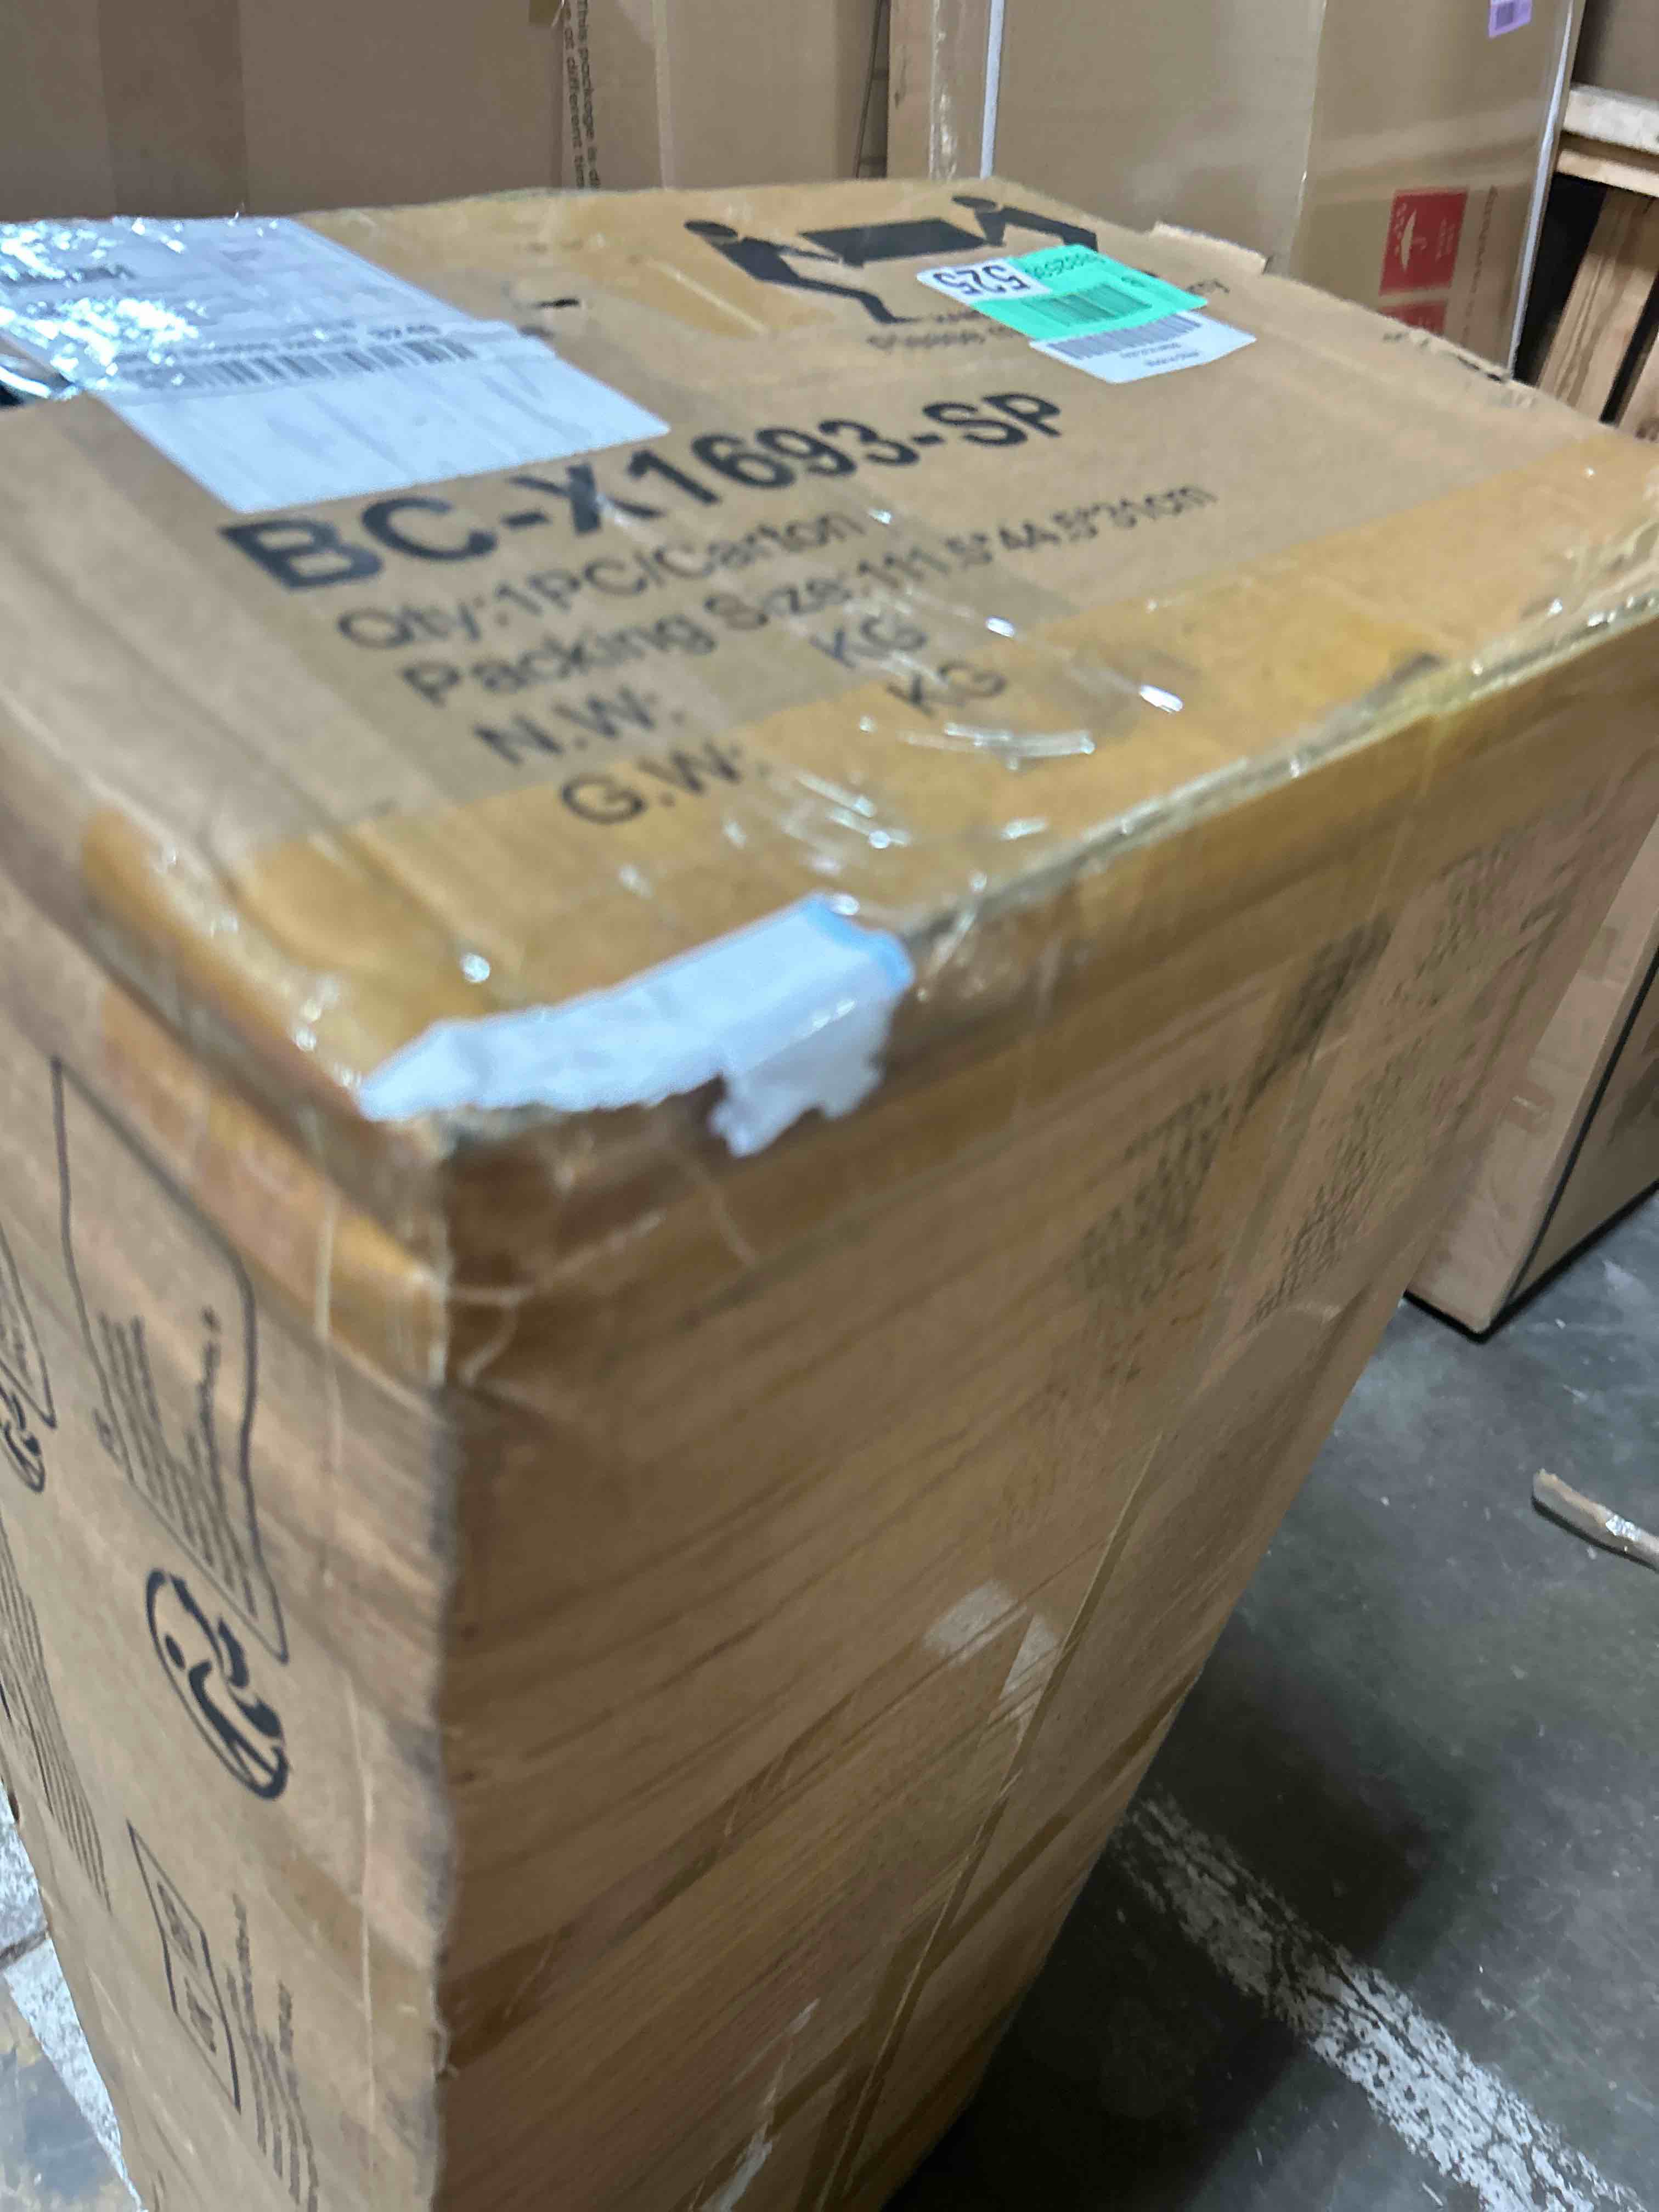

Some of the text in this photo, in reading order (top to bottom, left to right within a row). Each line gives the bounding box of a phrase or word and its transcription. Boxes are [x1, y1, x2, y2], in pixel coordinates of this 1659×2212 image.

[933, 264, 1031, 295] 525
[221, 392, 1061, 592] BC-X1693-SP
[399, 613, 717, 708] Packing
[808, 610, 928, 670] KG
[883, 658, 1008, 718] KG
